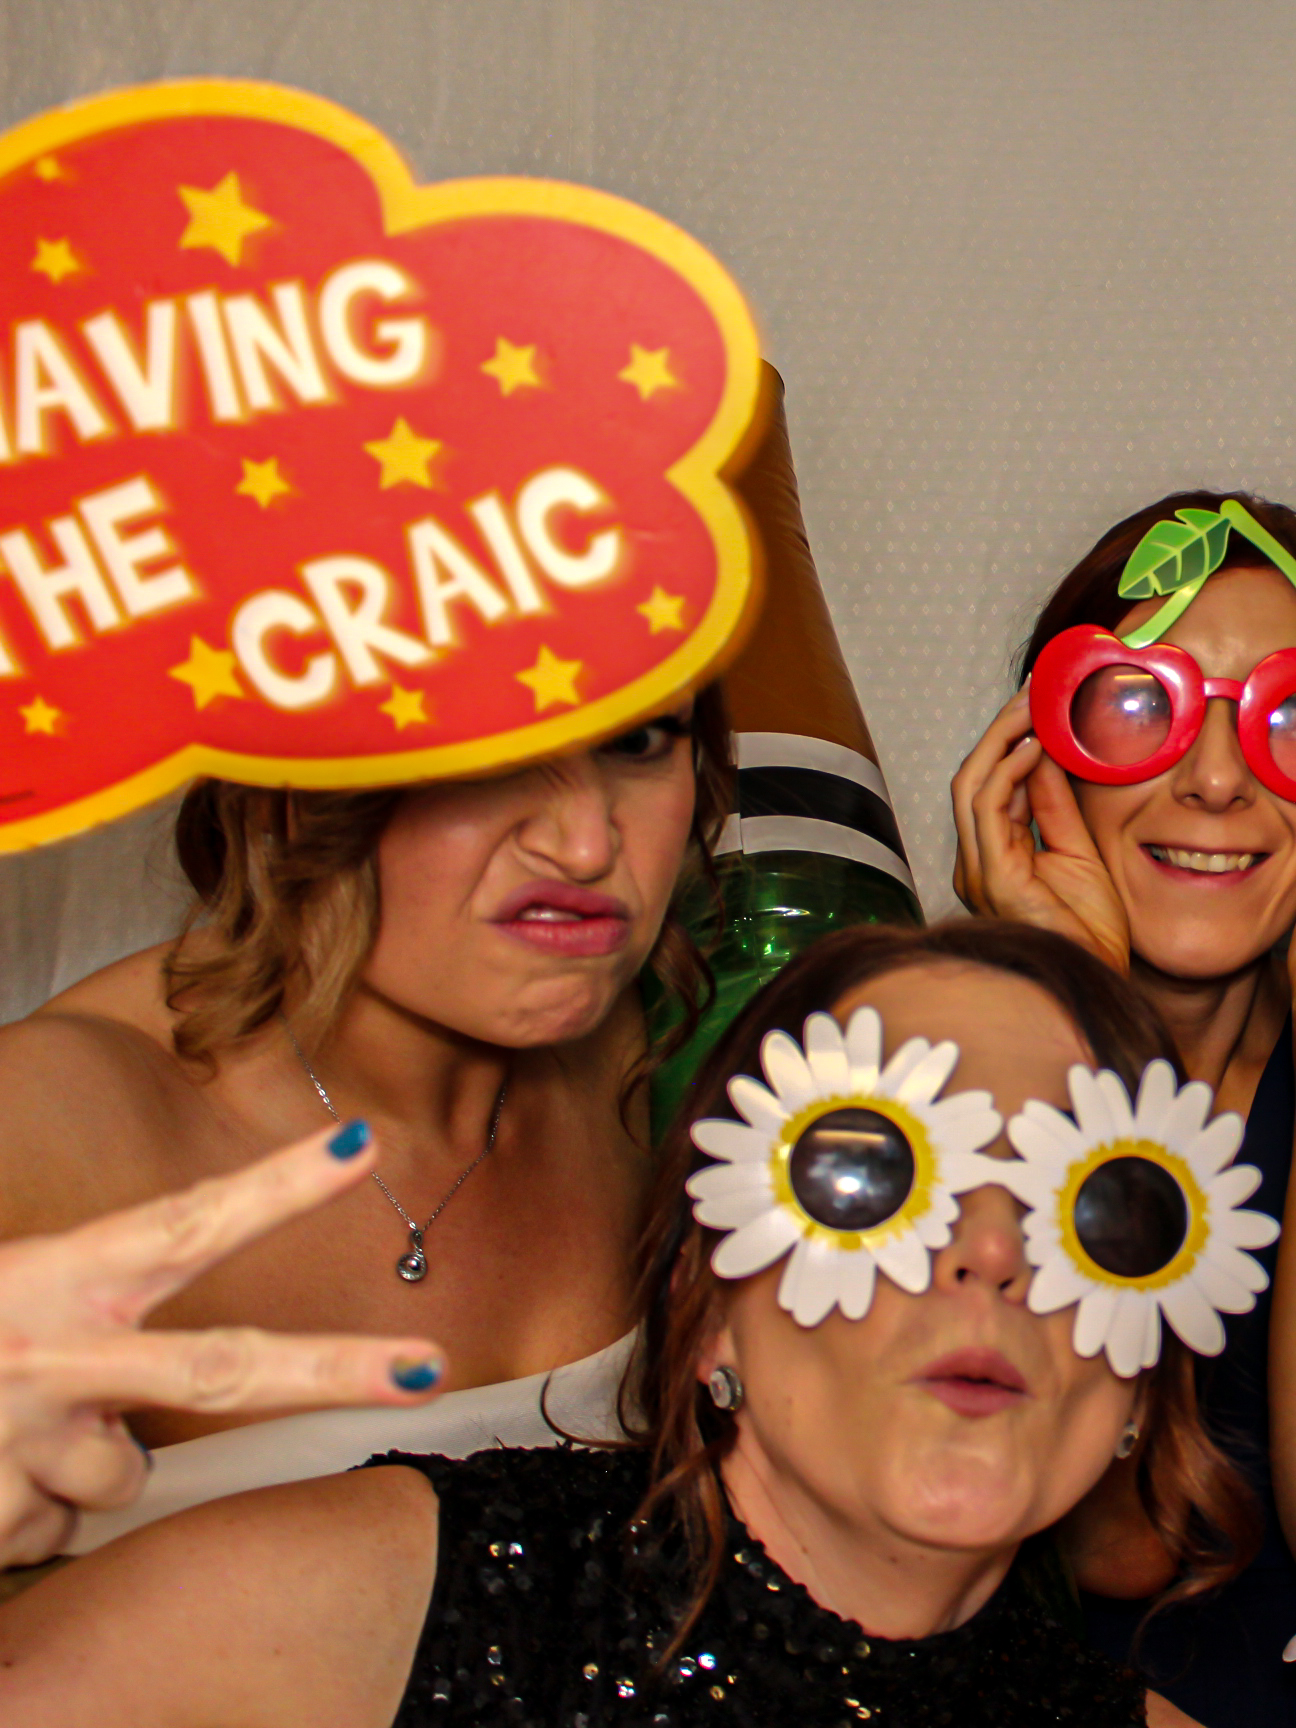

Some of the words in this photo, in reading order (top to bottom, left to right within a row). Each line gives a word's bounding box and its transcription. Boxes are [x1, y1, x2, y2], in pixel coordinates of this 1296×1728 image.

[0, 259, 426, 462] AVING
[0, 475, 198, 676] HE
[231, 467, 620, 709] CRAIC
